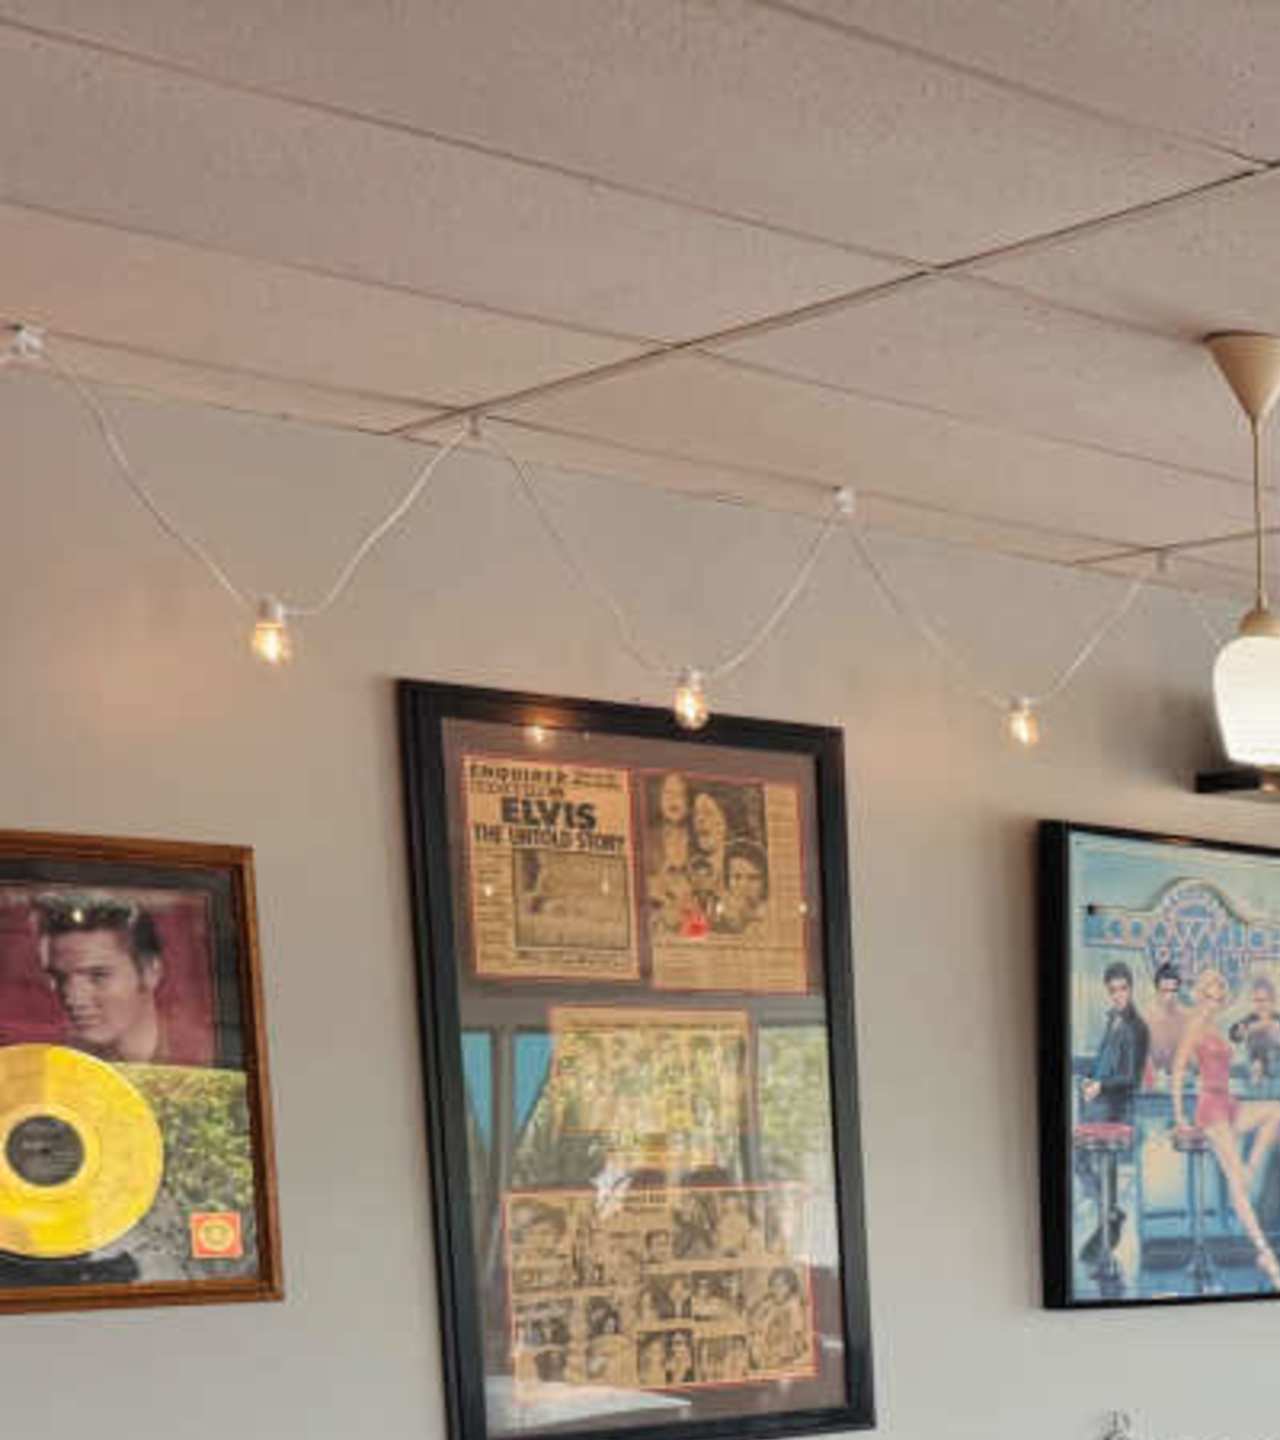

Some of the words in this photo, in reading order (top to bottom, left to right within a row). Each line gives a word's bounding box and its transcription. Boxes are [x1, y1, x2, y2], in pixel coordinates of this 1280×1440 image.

[501, 796, 597, 830] ELVIS
[474, 823, 502, 844] THE
[509, 825, 574, 849] UNTOLD
[578, 832, 626, 855] STORY
